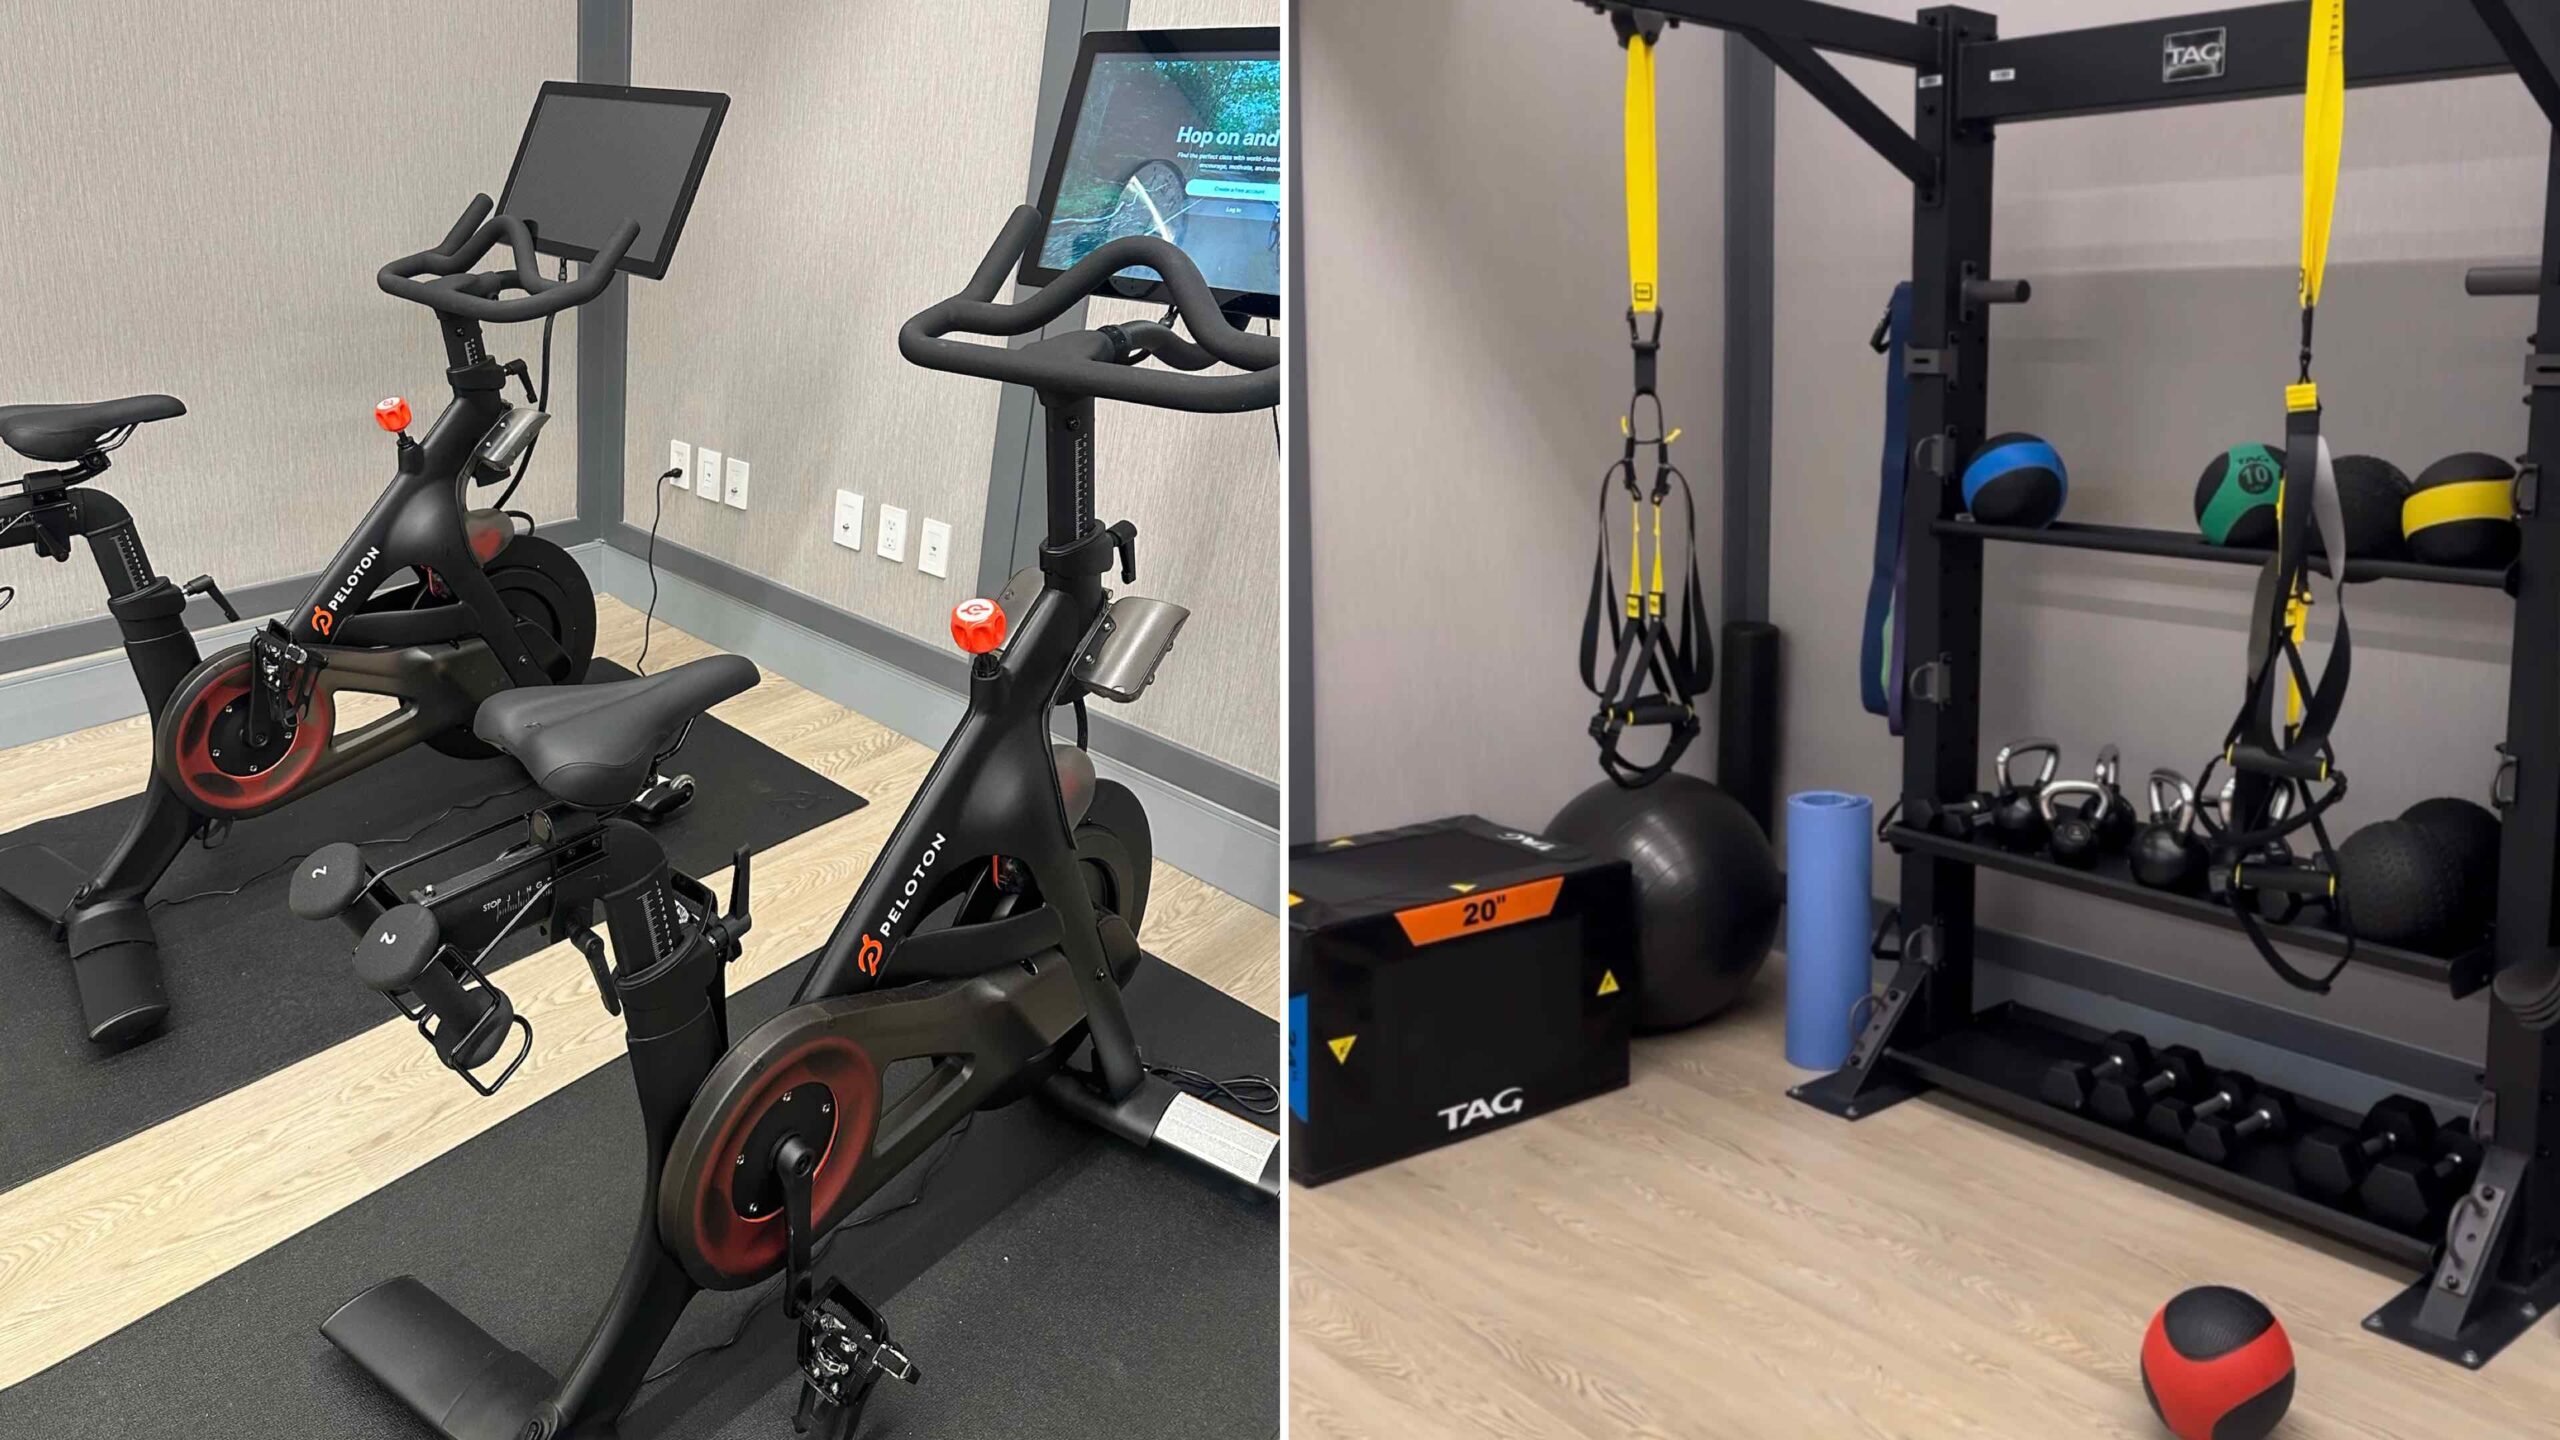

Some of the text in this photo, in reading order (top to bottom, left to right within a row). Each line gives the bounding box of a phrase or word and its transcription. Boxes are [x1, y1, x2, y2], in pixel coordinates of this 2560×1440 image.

[2165, 42, 2221, 65] TAG
[1176, 126, 1280, 148] Hop on and
[1225, 205, 1236, 214] Log
[2242, 465, 2269, 485] 10
[328, 546, 380, 611] PELOTON
[312, 865, 327, 879] 2
[880, 832, 946, 937] PELOTON
[483, 898, 502, 912] STOP
[1463, 895, 1506, 926] 20"
[380, 931, 397, 945] 2
[1437, 1087, 1524, 1130] TAG
